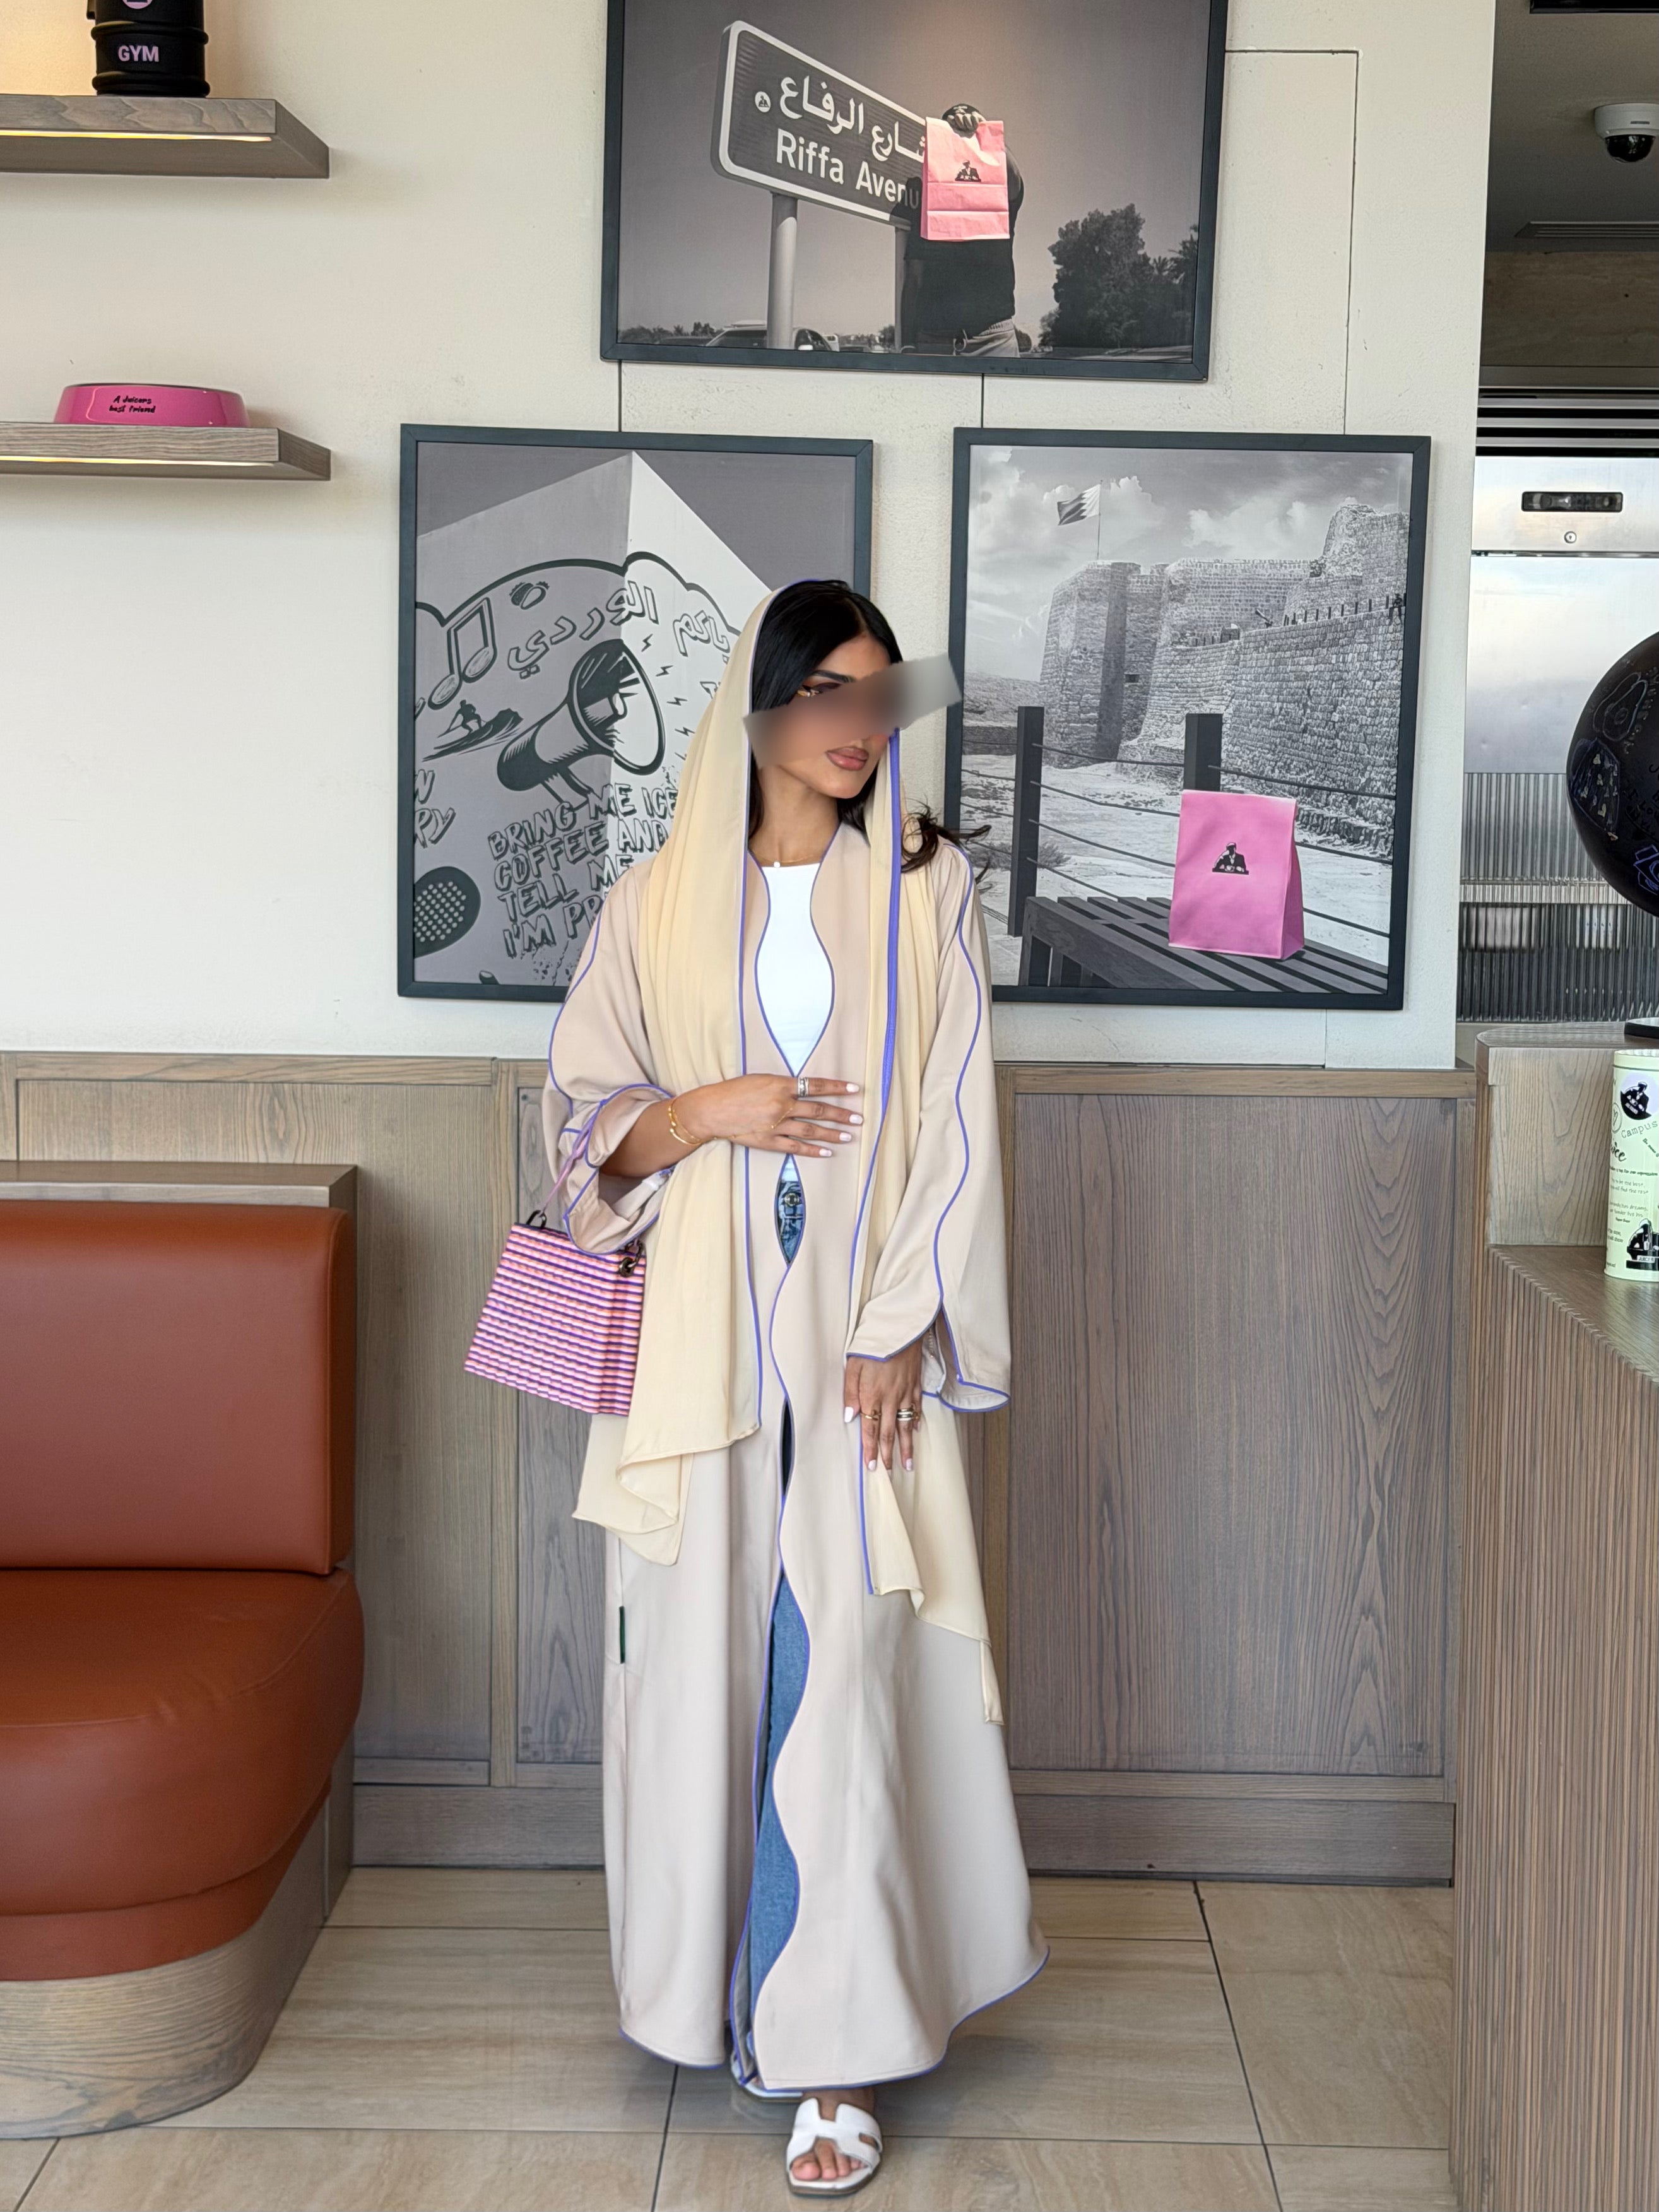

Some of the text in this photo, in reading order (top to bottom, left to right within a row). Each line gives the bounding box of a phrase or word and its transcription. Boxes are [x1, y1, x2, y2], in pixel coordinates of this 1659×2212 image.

[118, 45, 159, 62] GYM
[780, 76, 864, 134] الرفاع
[776, 128, 919, 210] Riffa Avenu
[109, 405, 156, 413] best friend
[507, 581, 659, 679] الوردي
[488, 803, 576, 861] BRING
[587, 783, 637, 820] ME
[494, 818, 669, 892] COFFEE AND
[497, 874, 580, 922] TELL
[504, 914, 557, 959] I'M
[1621, 1121, 1658, 1139] Campus
